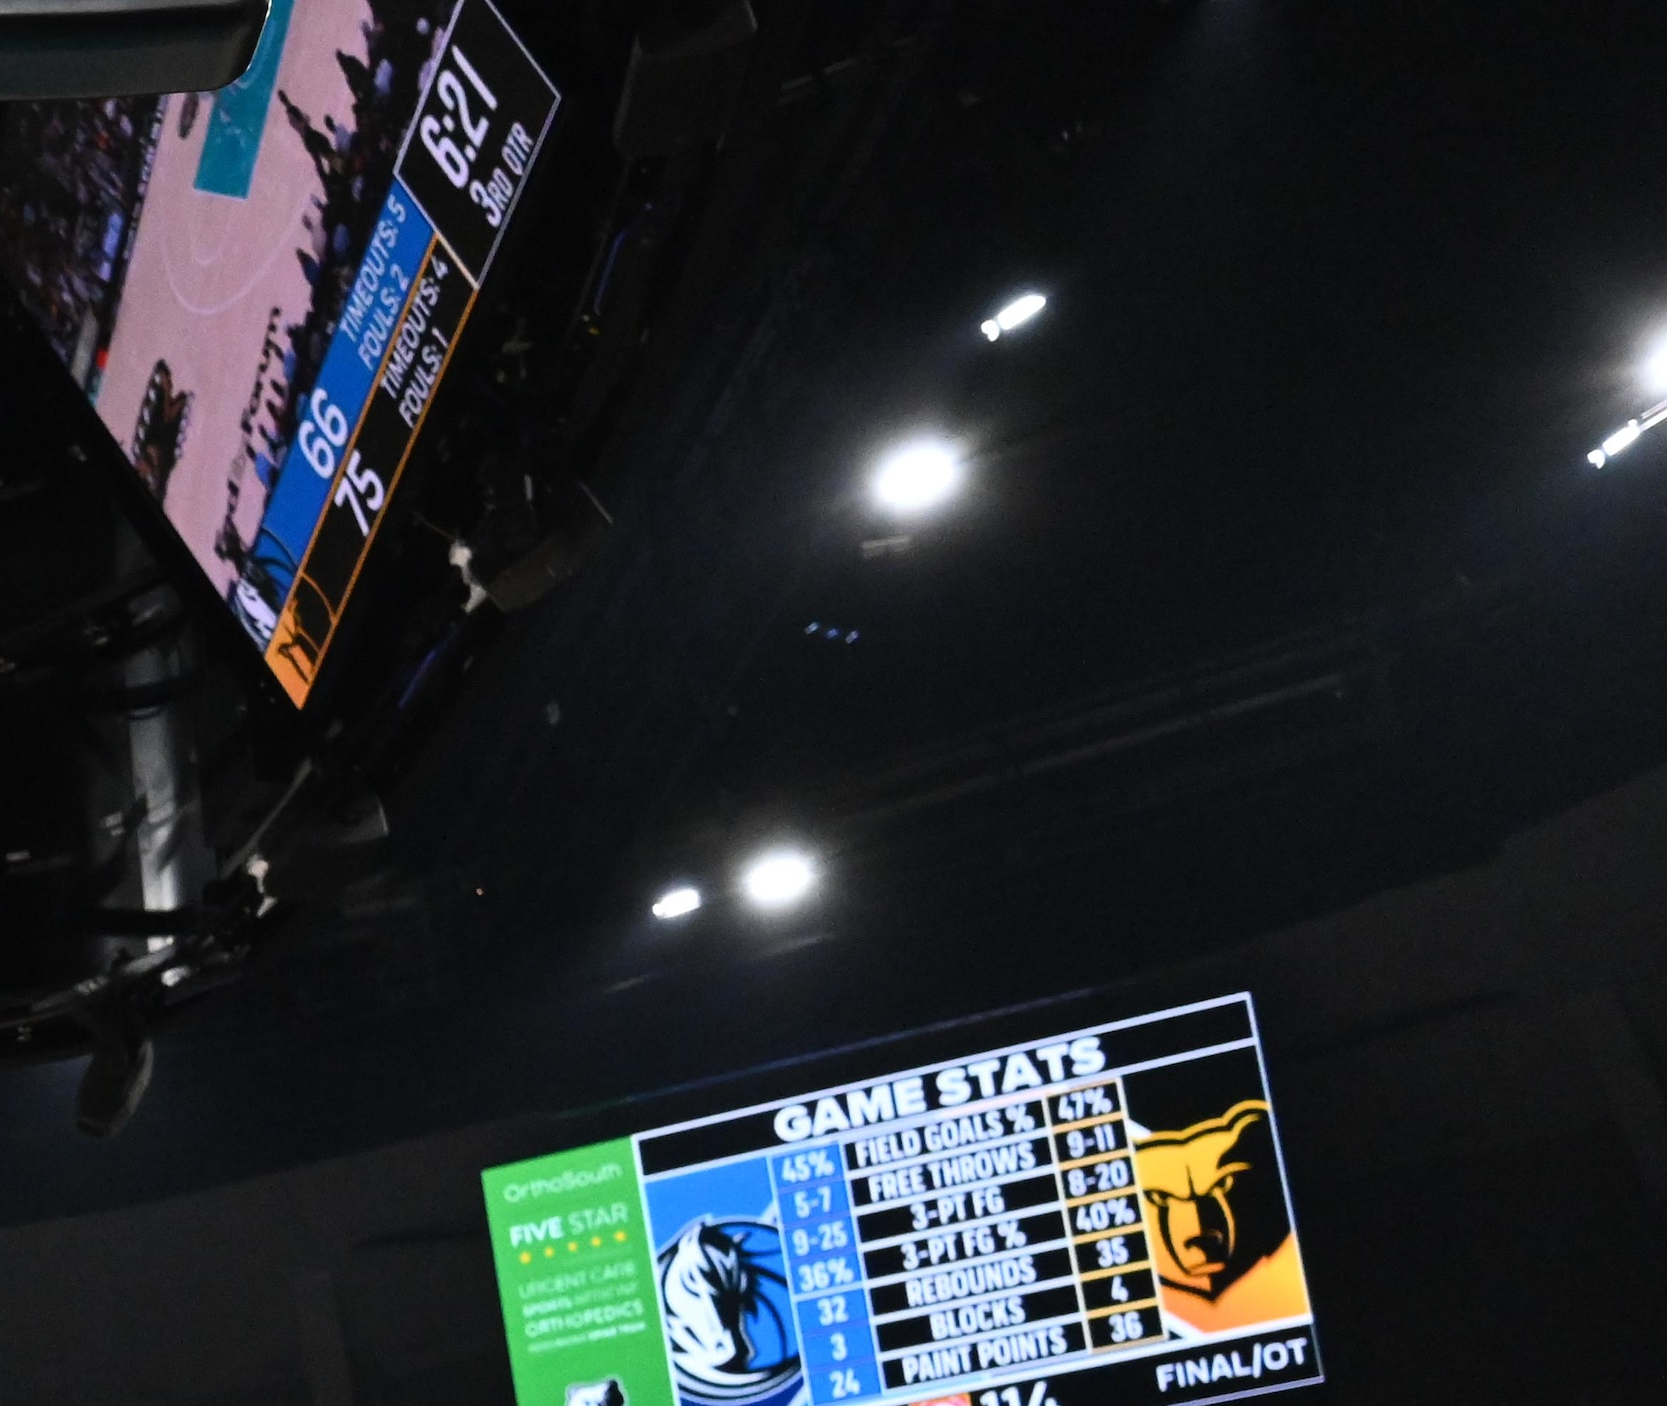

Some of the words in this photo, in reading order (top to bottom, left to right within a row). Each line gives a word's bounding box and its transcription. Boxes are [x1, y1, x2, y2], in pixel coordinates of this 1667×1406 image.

[420, 45, 497, 189] 6:21
[469, 169, 514, 229] 3RD
[339, 214, 398, 343] TIMEOUTS:
[389, 195, 407, 225] 5
[357, 284, 401, 372] FOULS:
[393, 267, 410, 294] 2
[379, 277, 440, 400] TIMEOUTS:
[430, 256, 449, 279] 4
[298, 387, 348, 480] 66
[398, 345, 443, 431] FOULS:
[334, 450, 384, 537] 75
[773, 1077, 927, 1143] GAME
[935, 1036, 1106, 1106] STATS
[781, 1152, 836, 1184] 45%
[854, 1128, 923, 1168] FIELD
[926, 1112, 1004, 1152] GOALS
[1005, 1103, 1036, 1133] %
[1057, 1087, 1114, 1121] 47%
[504, 1163, 622, 1202] OrthoSouth
[792, 1221, 849, 1256] 9-25
[910, 1191, 967, 1230] 3-PT
[973, 1185, 1006, 1216] FG
[1067, 1159, 1129, 1197] 8-20
[794, 1187, 832, 1219] 5-7
[868, 1162, 926, 1202] FREE
[929, 1141, 1037, 1188] THROWS
[1067, 1124, 1116, 1158] 9-11
[509, 1215, 564, 1248] FIVE
[568, 1202, 629, 1235] STAR
[798, 1257, 855, 1291] 36%
[901, 1232, 957, 1271] 3-PT
[962, 1226, 995, 1257] FG
[997, 1219, 1027, 1248] %
[1075, 1192, 1136, 1232] 40%
[819, 1295, 849, 1326] 32
[906, 1254, 1036, 1307] REBOUNDS
[1096, 1236, 1129, 1268] 35
[831, 1332, 847, 1362] 3
[929, 1295, 1026, 1341] BLOCKS
[1111, 1276, 1129, 1302] 4
[829, 1368, 860, 1399] 24
[902, 1349, 973, 1384] PAINT
[977, 1325, 1067, 1370] POINTS
[1108, 1310, 1143, 1344] 36
[1156, 1336, 1309, 1394] FINAL/OT
